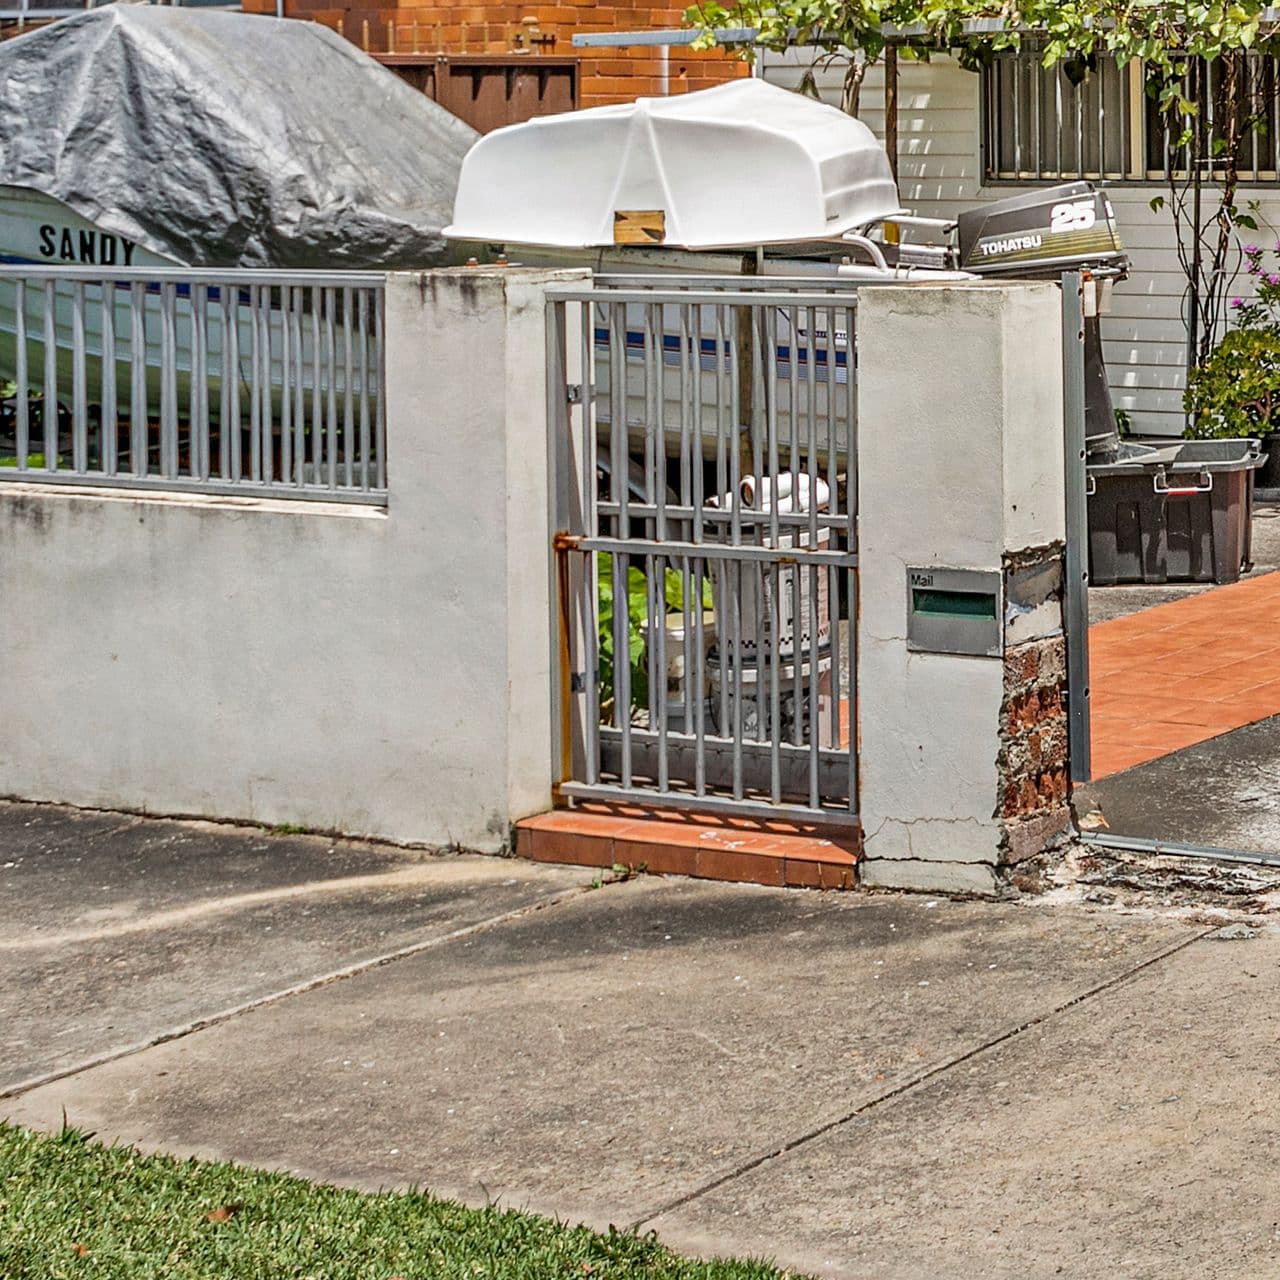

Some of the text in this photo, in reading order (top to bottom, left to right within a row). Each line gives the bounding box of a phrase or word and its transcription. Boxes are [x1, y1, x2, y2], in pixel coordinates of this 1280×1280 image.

[1051, 200, 1096, 234] 25
[39, 224, 136, 266] SANDY
[981, 235, 1042, 256] TOHATSU
[911, 574, 934, 587] Mail
